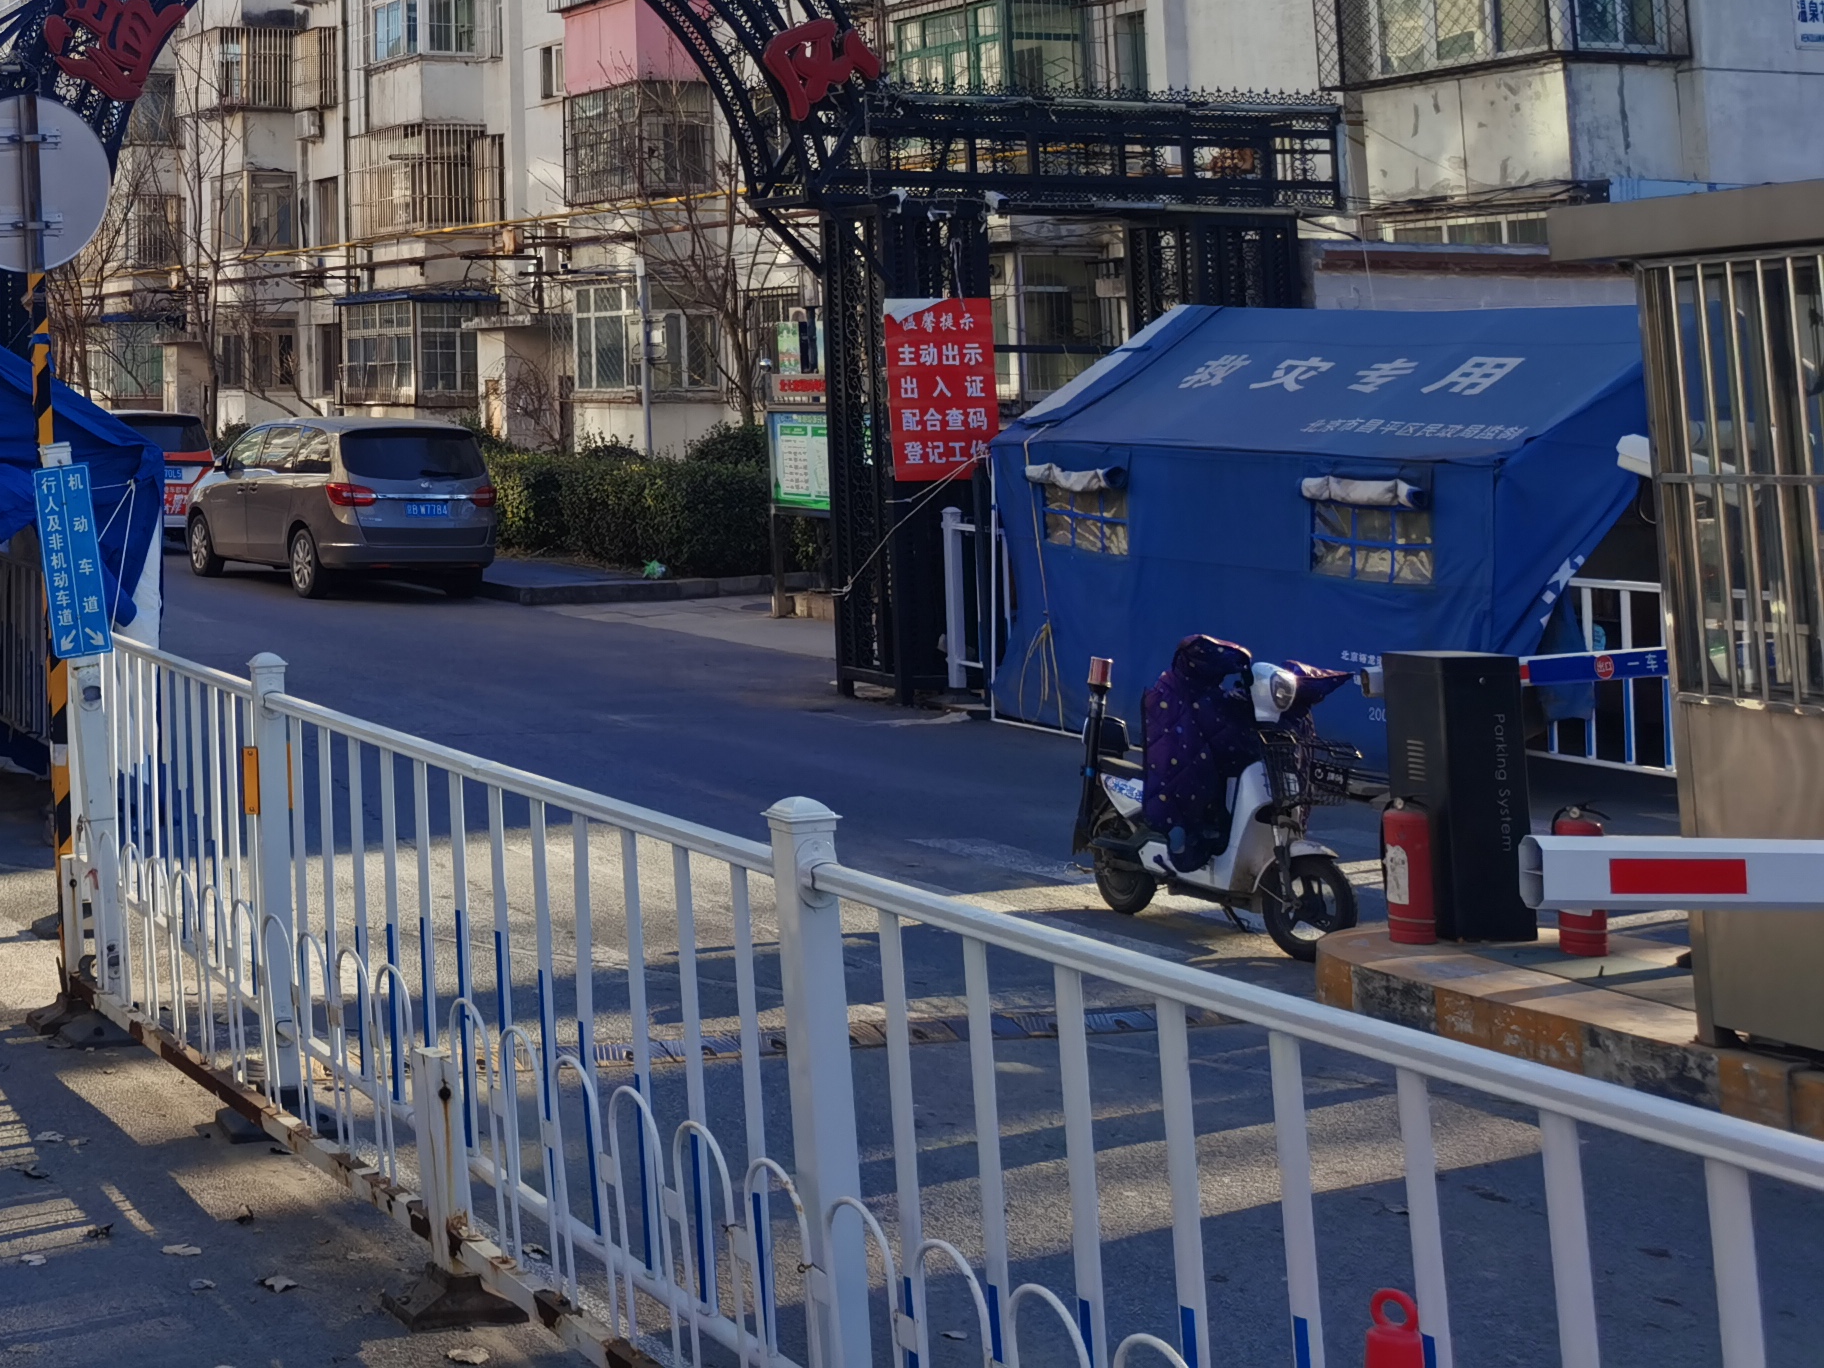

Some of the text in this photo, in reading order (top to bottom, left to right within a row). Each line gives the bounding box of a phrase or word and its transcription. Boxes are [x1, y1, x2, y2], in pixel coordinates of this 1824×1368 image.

[902, 311, 975, 333] 温馨提示
[897, 343, 983, 366] 主动出示
[1177, 354, 1526, 395] 救灾专用
[900, 376, 986, 399] 出入证
[900, 407, 988, 431] 配合查码
[41, 477, 74, 627] 行人及非机动车道
[67, 473, 100, 614] 机动车道
[1626, 653, 1668, 673] 一车
[1493, 713, 1512, 852] Parking System
